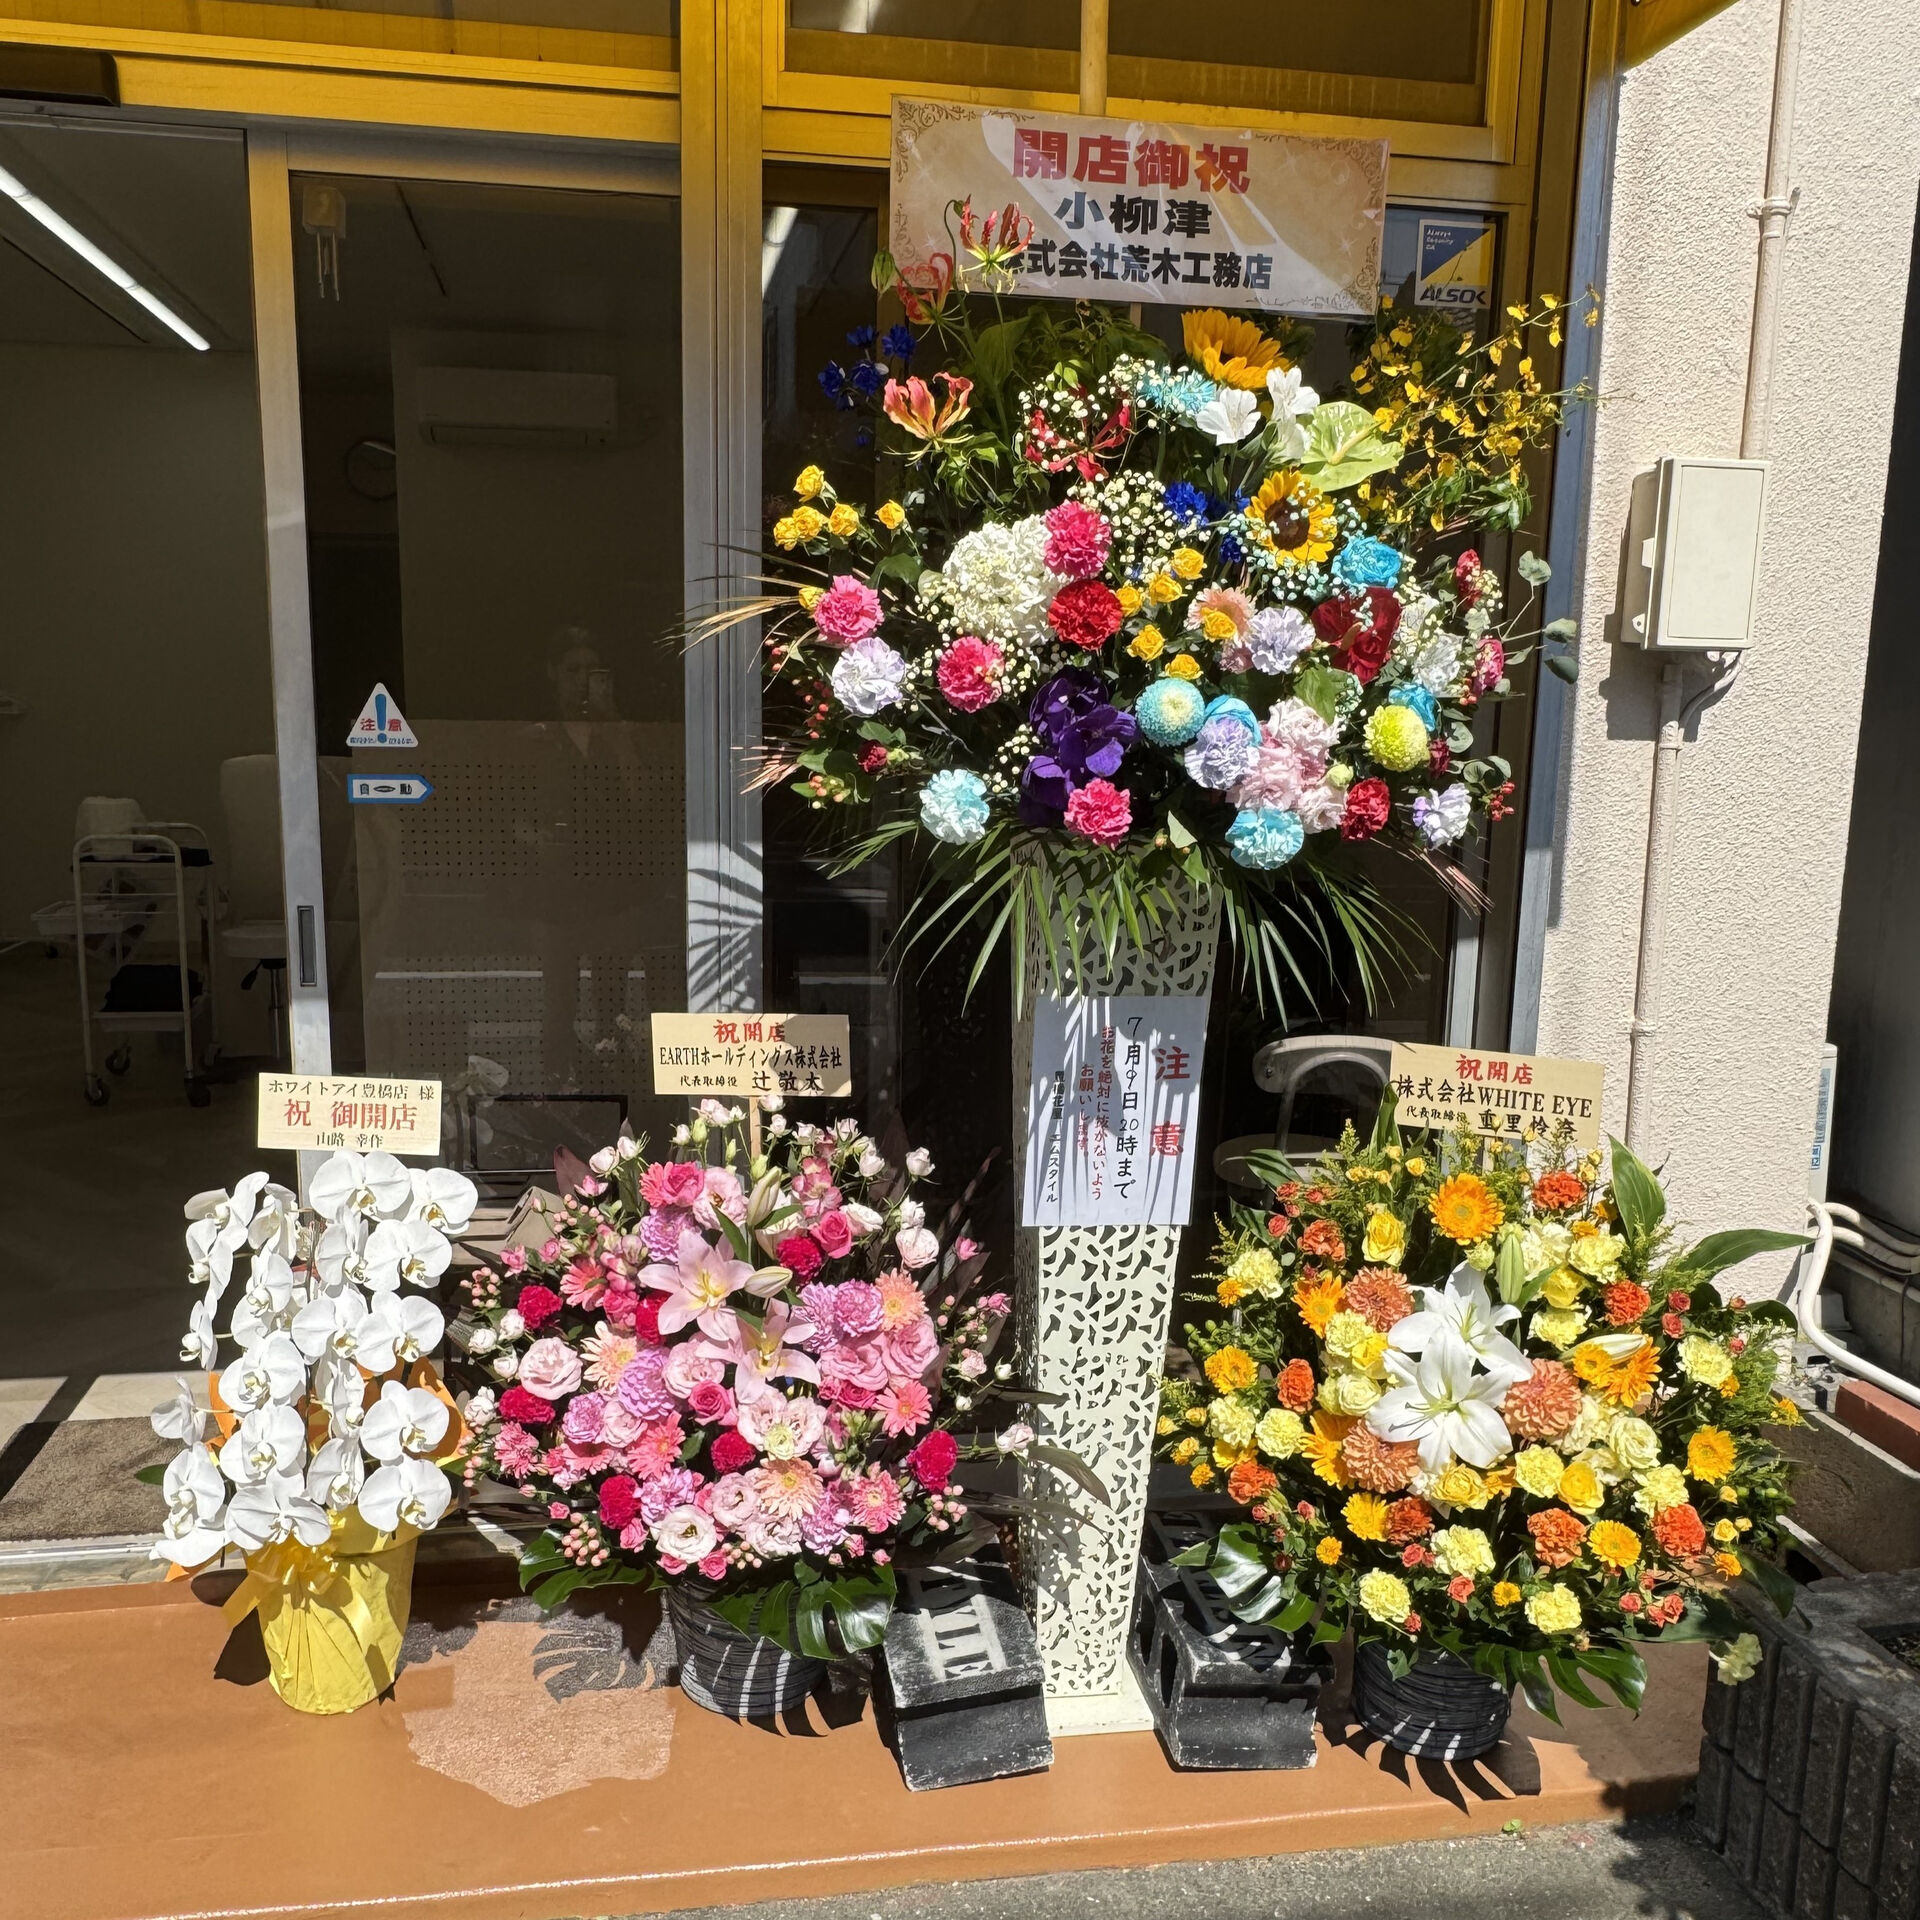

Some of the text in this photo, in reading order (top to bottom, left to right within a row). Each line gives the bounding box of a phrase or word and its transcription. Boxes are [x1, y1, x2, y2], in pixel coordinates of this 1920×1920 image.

[1013, 128, 1252, 195] 開店御祝
[1055, 191, 1213, 239] 小柳津
[1420, 286, 1487, 305] ALSOK
[713, 1019, 785, 1044] 祝開店
[659, 1045, 843, 1069] EARTHホールディングス株式会社
[1455, 1054, 1533, 1085] 祝開店
[284, 1098, 418, 1131] 祝 御開店
[1150, 1045, 1191, 1158] 注意
[1551, 1094, 1592, 1118] EYE
